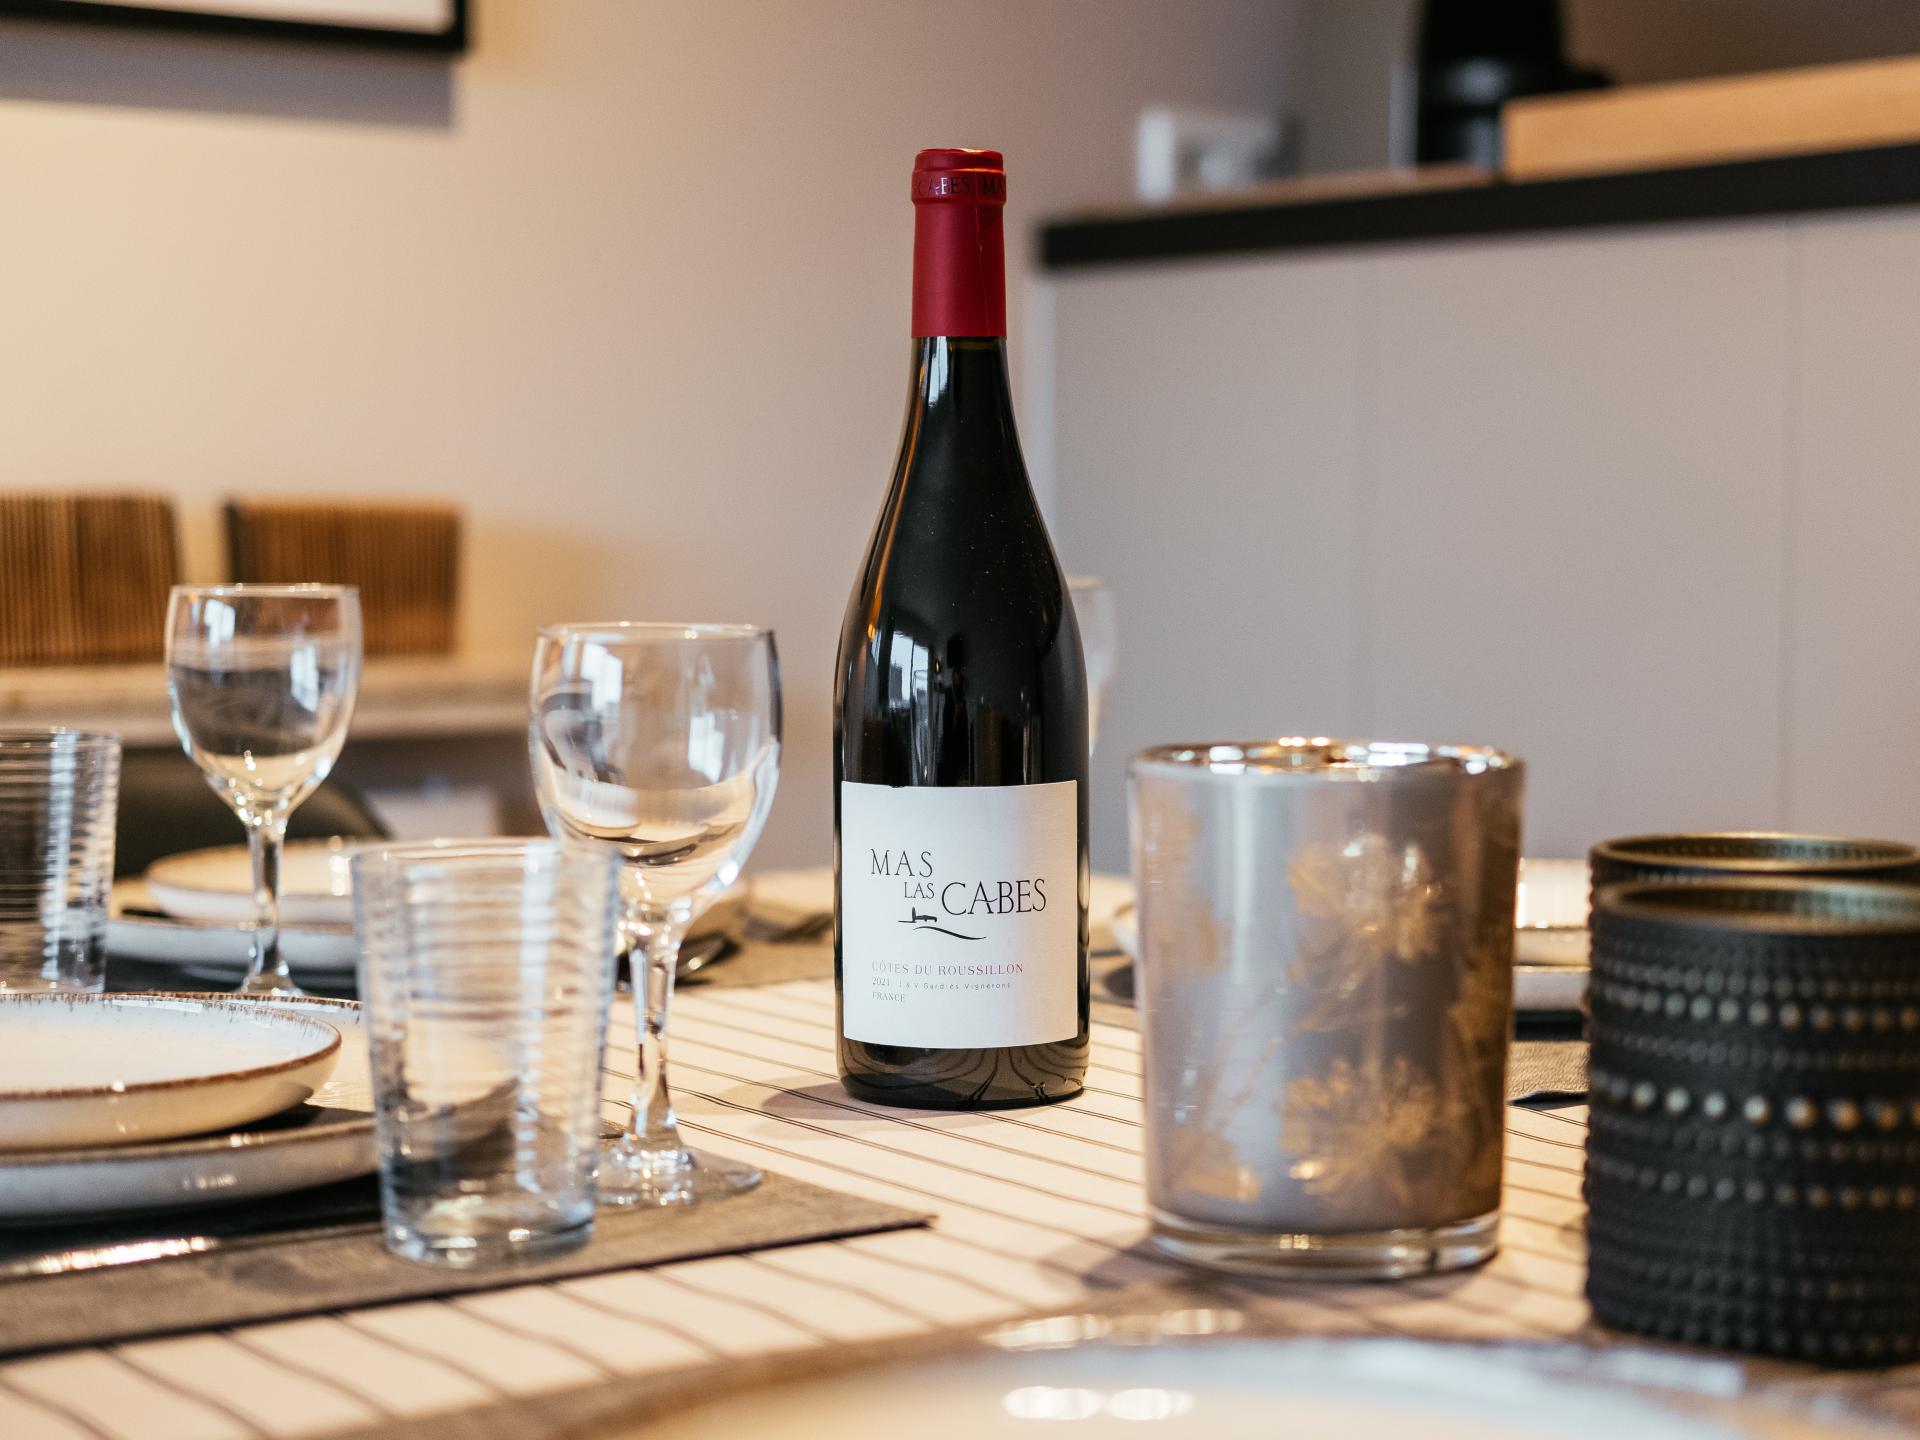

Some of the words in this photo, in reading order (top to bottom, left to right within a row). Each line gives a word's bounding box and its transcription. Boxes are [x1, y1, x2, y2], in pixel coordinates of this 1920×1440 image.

[870, 848, 933, 878] MAS
[904, 881, 935, 900] LAS
[941, 878, 1047, 916] CABES
[872, 959, 909, 975] CÔTES
[915, 963, 932, 976] DU
[938, 963, 1024, 976] ROUSSILLON
[872, 991, 906, 1003] FRANCE
